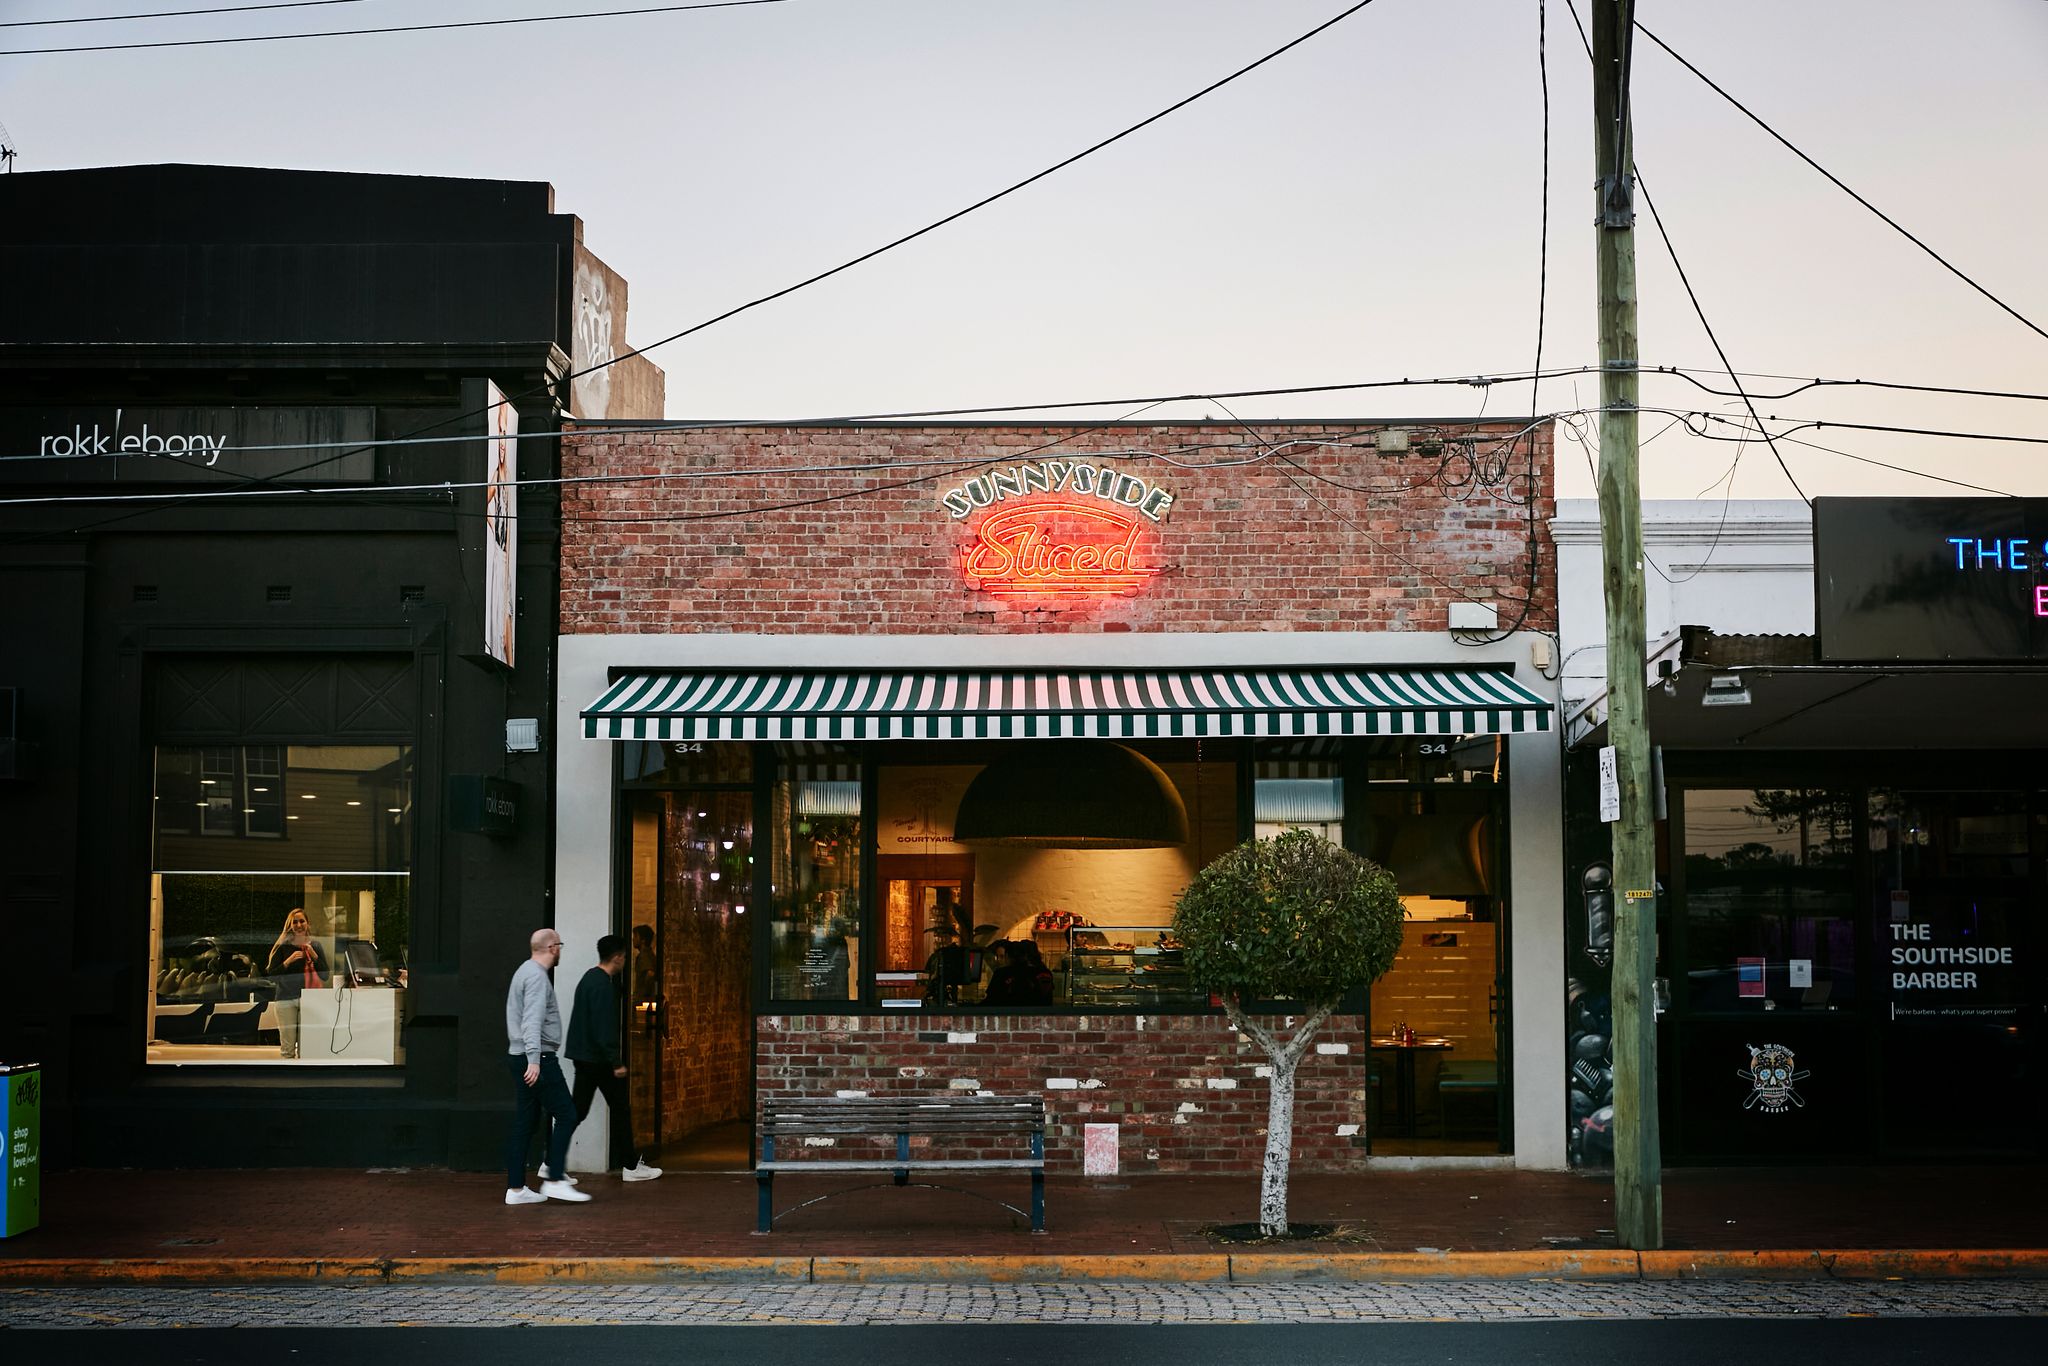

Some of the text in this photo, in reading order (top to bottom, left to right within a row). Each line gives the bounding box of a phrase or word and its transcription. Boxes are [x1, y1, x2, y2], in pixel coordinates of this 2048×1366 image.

[40, 424, 227, 466] rokk ebony
[942, 461, 1175, 522] SUNNYSIDE
[966, 502, 1160, 578] Sliced
[1945, 538, 2029, 571] THE
[674, 743, 703, 753] 34
[1419, 744, 1448, 754] 34
[1890, 924, 1931, 941] THE
[1891, 947, 2013, 964] SOUTHSIDE
[1892, 972, 1978, 989] BARBER
[1961, 1009, 1975, 1017] your
[1976, 1009, 1994, 1017] super
[1994, 1008, 2017, 1016] power?
[13, 1126, 29, 1140] shop
[13, 1142, 28, 1154] stay
[13, 1156, 26, 1169] love
